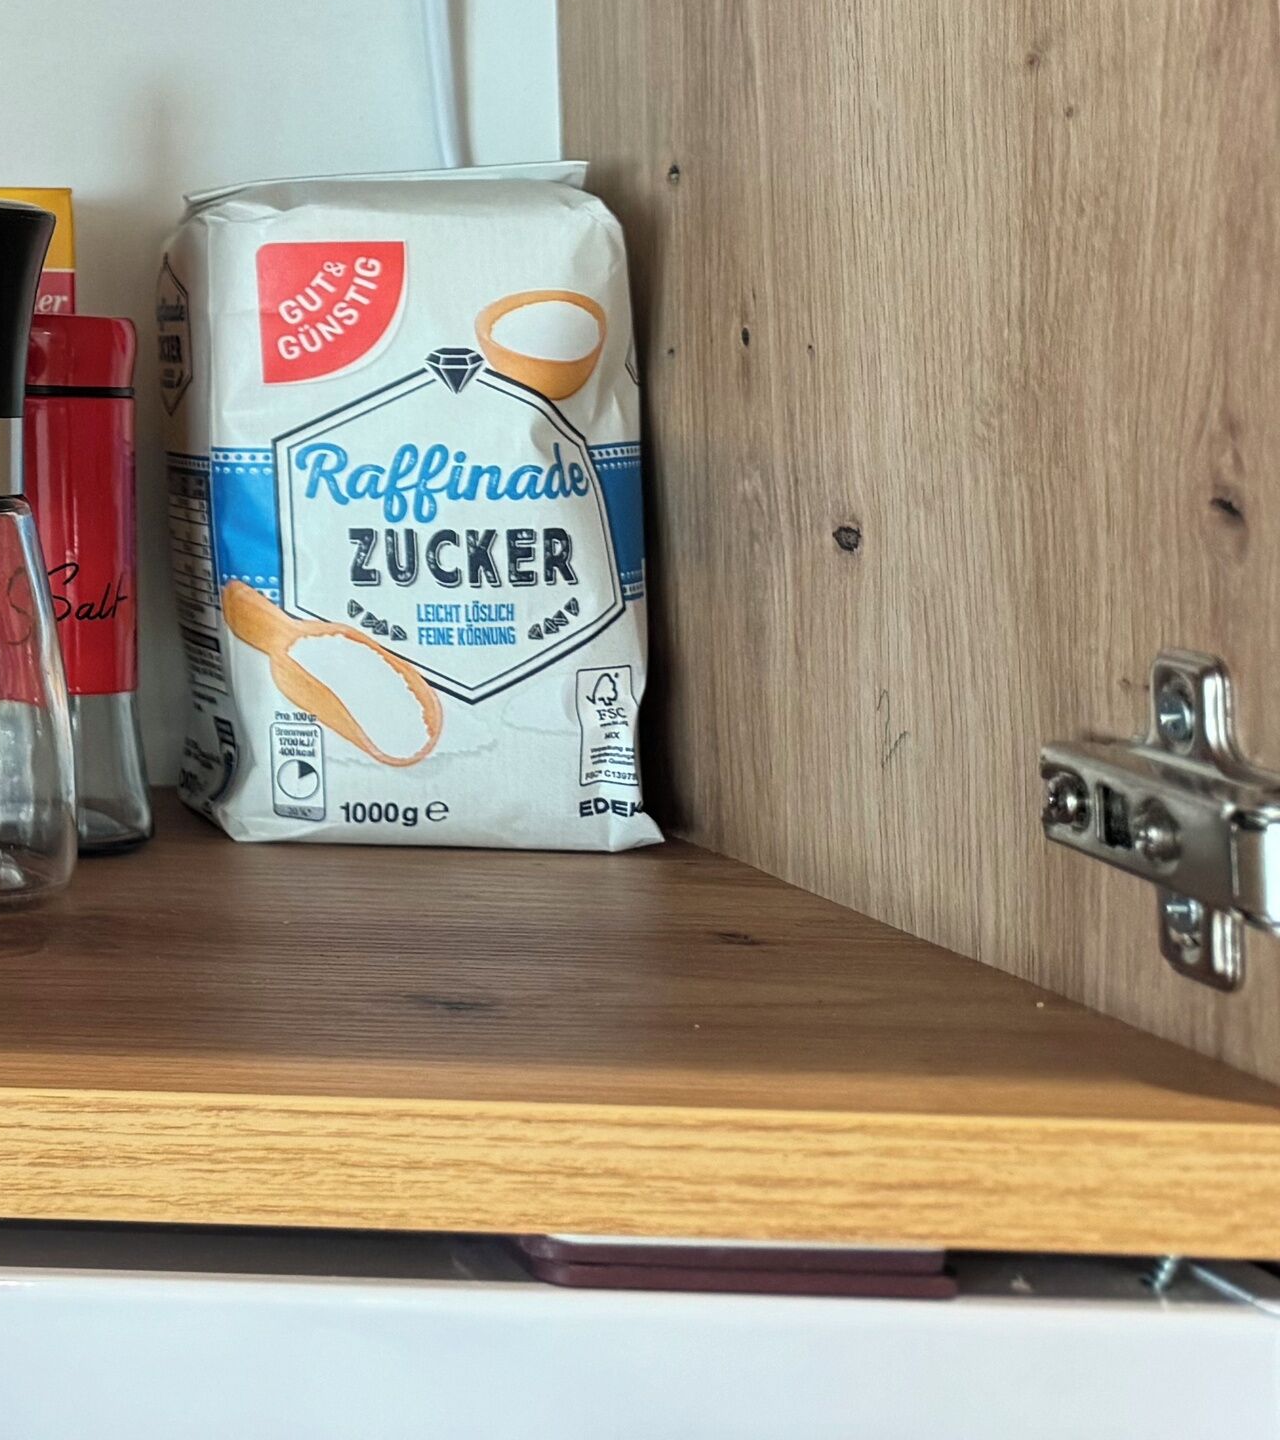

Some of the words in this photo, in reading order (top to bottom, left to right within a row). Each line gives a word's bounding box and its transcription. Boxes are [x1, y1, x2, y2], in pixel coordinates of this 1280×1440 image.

[276, 255, 382, 361] GÜNSTIG
[294, 442, 589, 524] Raffinade
[348, 526, 578, 589] ZUCKER
[40, 562, 128, 622] Salt
[417, 604, 460, 624] LEICHT
[465, 602, 515, 622] LÖSLICH
[418, 628, 455, 646] FEINE
[457, 626, 516, 646] KÖRNUNG
[596, 708, 626, 720] FSC
[275, 727, 318, 737] Brennwert
[279, 738, 298, 746] 1700
